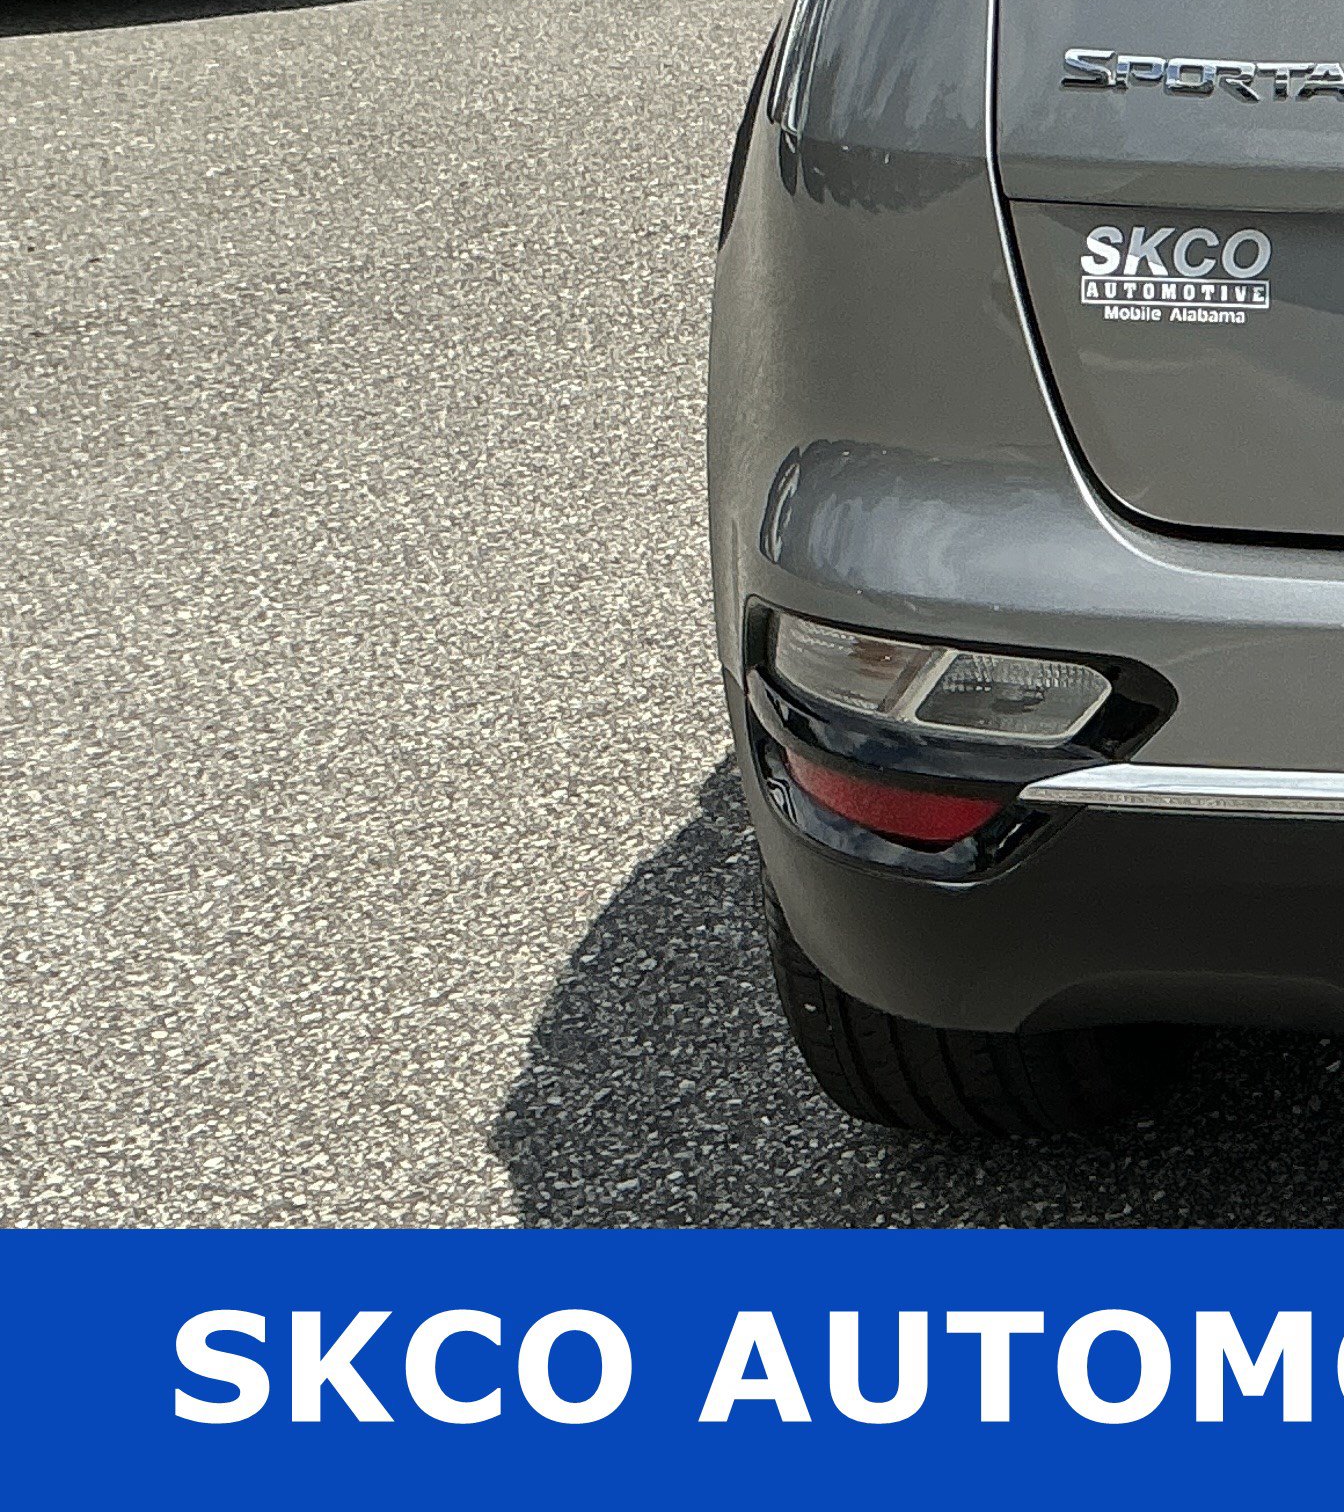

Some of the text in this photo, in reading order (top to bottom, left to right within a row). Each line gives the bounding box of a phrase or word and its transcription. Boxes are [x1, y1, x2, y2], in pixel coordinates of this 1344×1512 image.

[1081, 226, 1271, 278] SKCO
[1086, 281, 1266, 303] AUTOMOTIVE
[1104, 305, 1246, 324] Mobile Alabama
